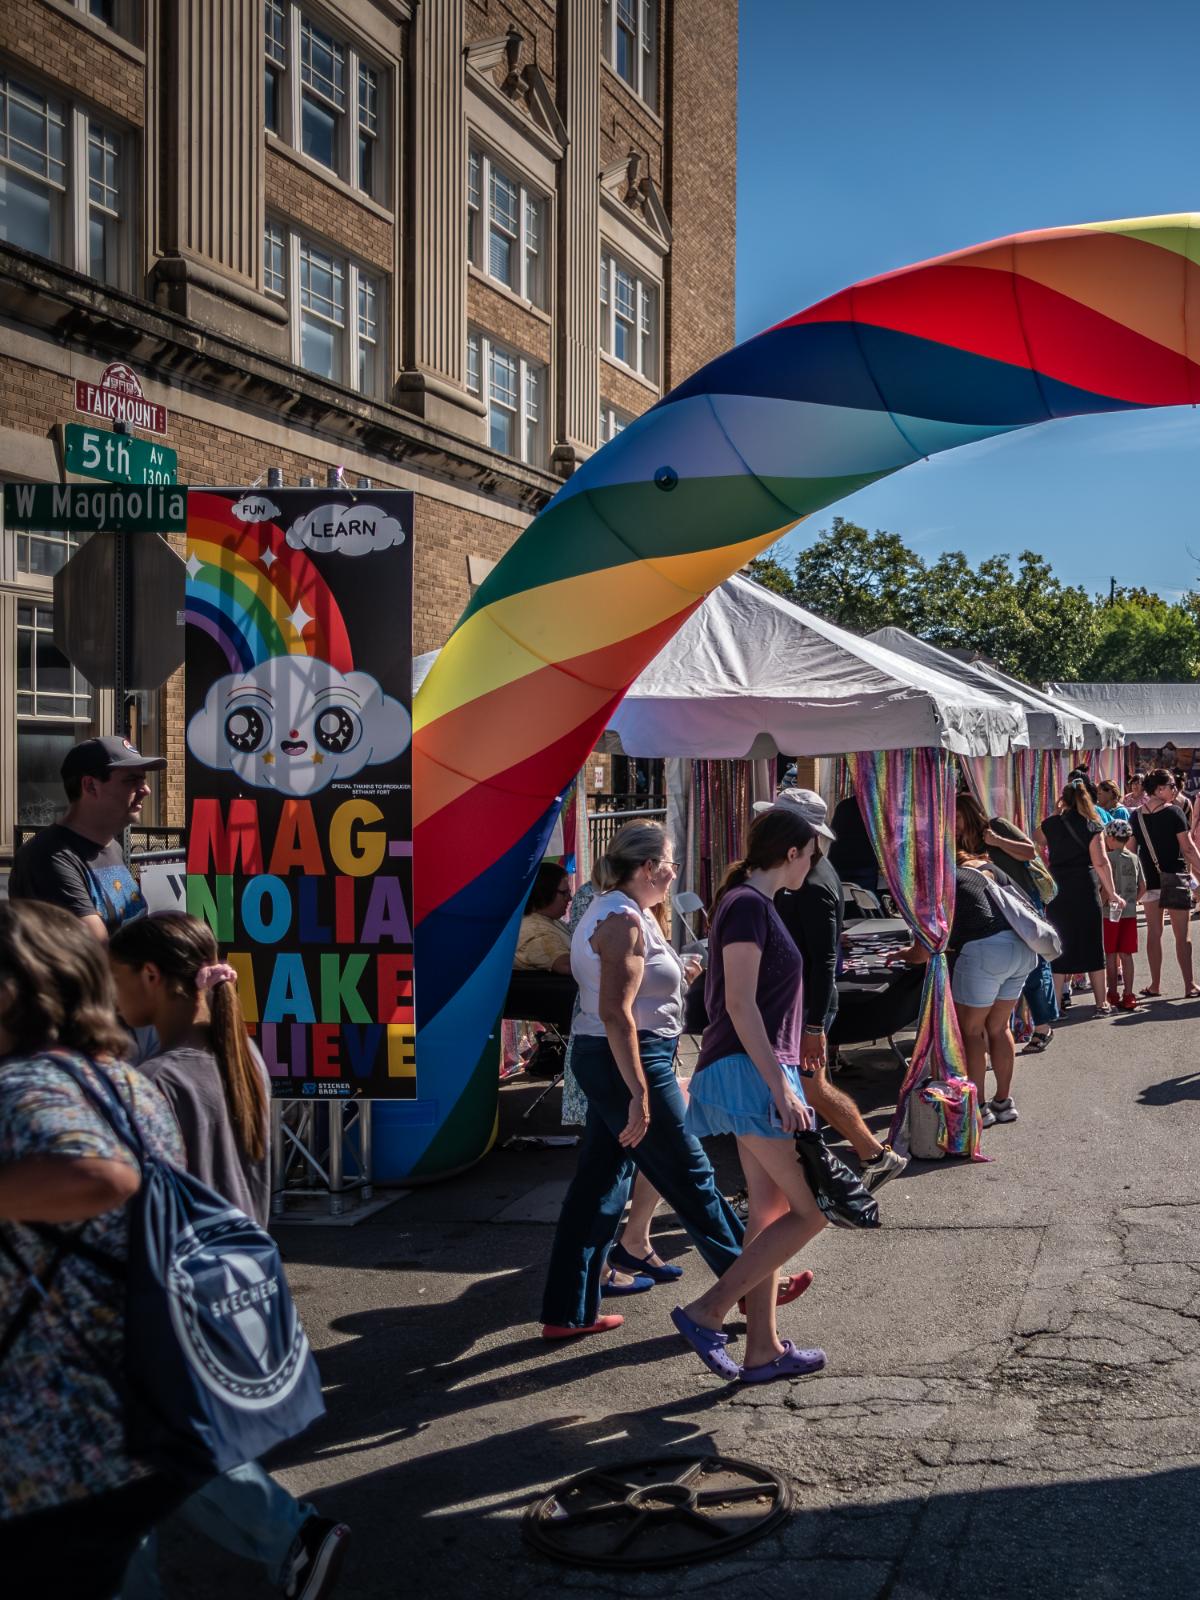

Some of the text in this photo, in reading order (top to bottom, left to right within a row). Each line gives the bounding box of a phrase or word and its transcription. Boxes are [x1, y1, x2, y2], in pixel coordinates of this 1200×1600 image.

[87, 386, 158, 430] FAIRMOUNT
[82, 432, 130, 475] 5th
[143, 467, 170, 485] 1300
[15, 485, 184, 529] W Magnolia
[242, 504, 266, 515] FUN
[311, 521, 376, 539] LEARN
[187, 799, 413, 877] MAG-
[187, 874, 413, 944] NOLIA
[248, 1023, 416, 1077] LIEVE
